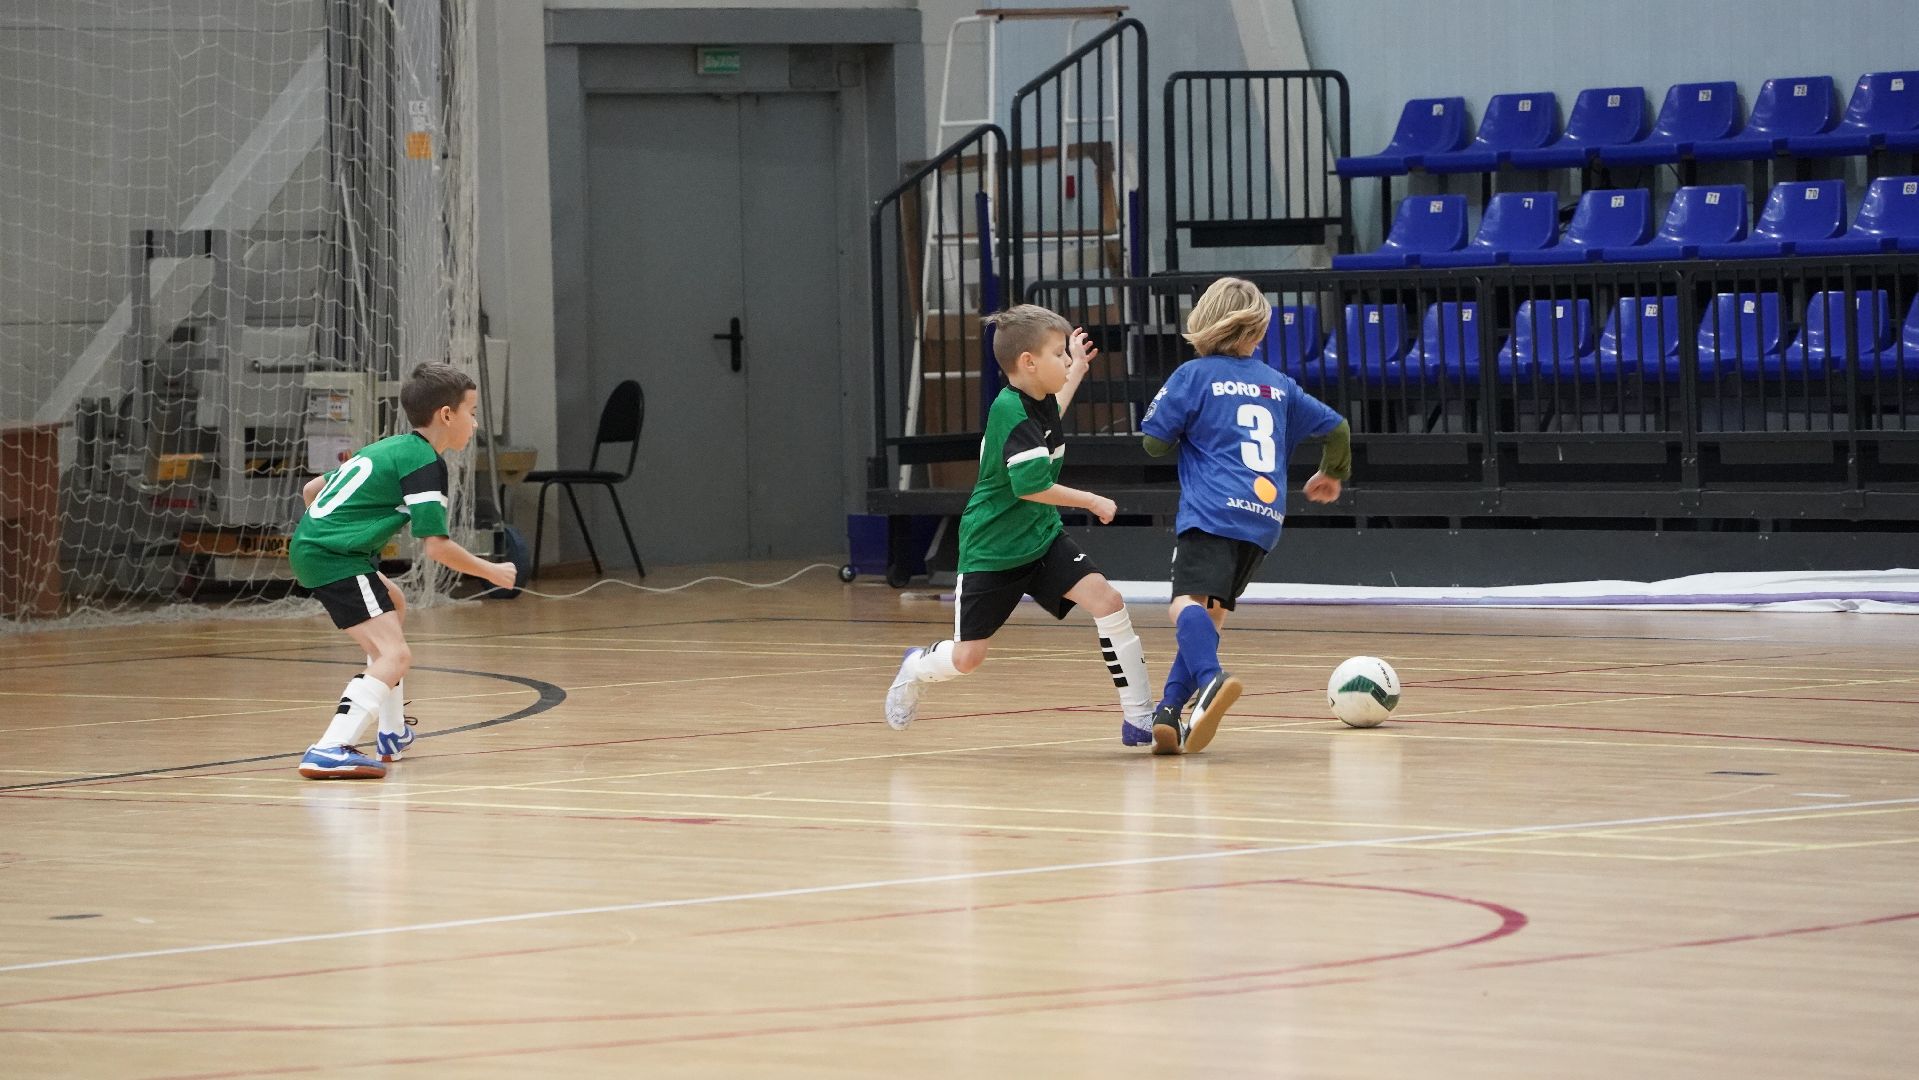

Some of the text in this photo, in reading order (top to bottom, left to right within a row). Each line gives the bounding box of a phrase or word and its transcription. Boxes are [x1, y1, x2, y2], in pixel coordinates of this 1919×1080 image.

[1806, 188, 1818, 199] 70
[1904, 183, 1917, 194] 69
[1211, 381, 1283, 402] BORDER
[1236, 403, 1276, 473] 3
